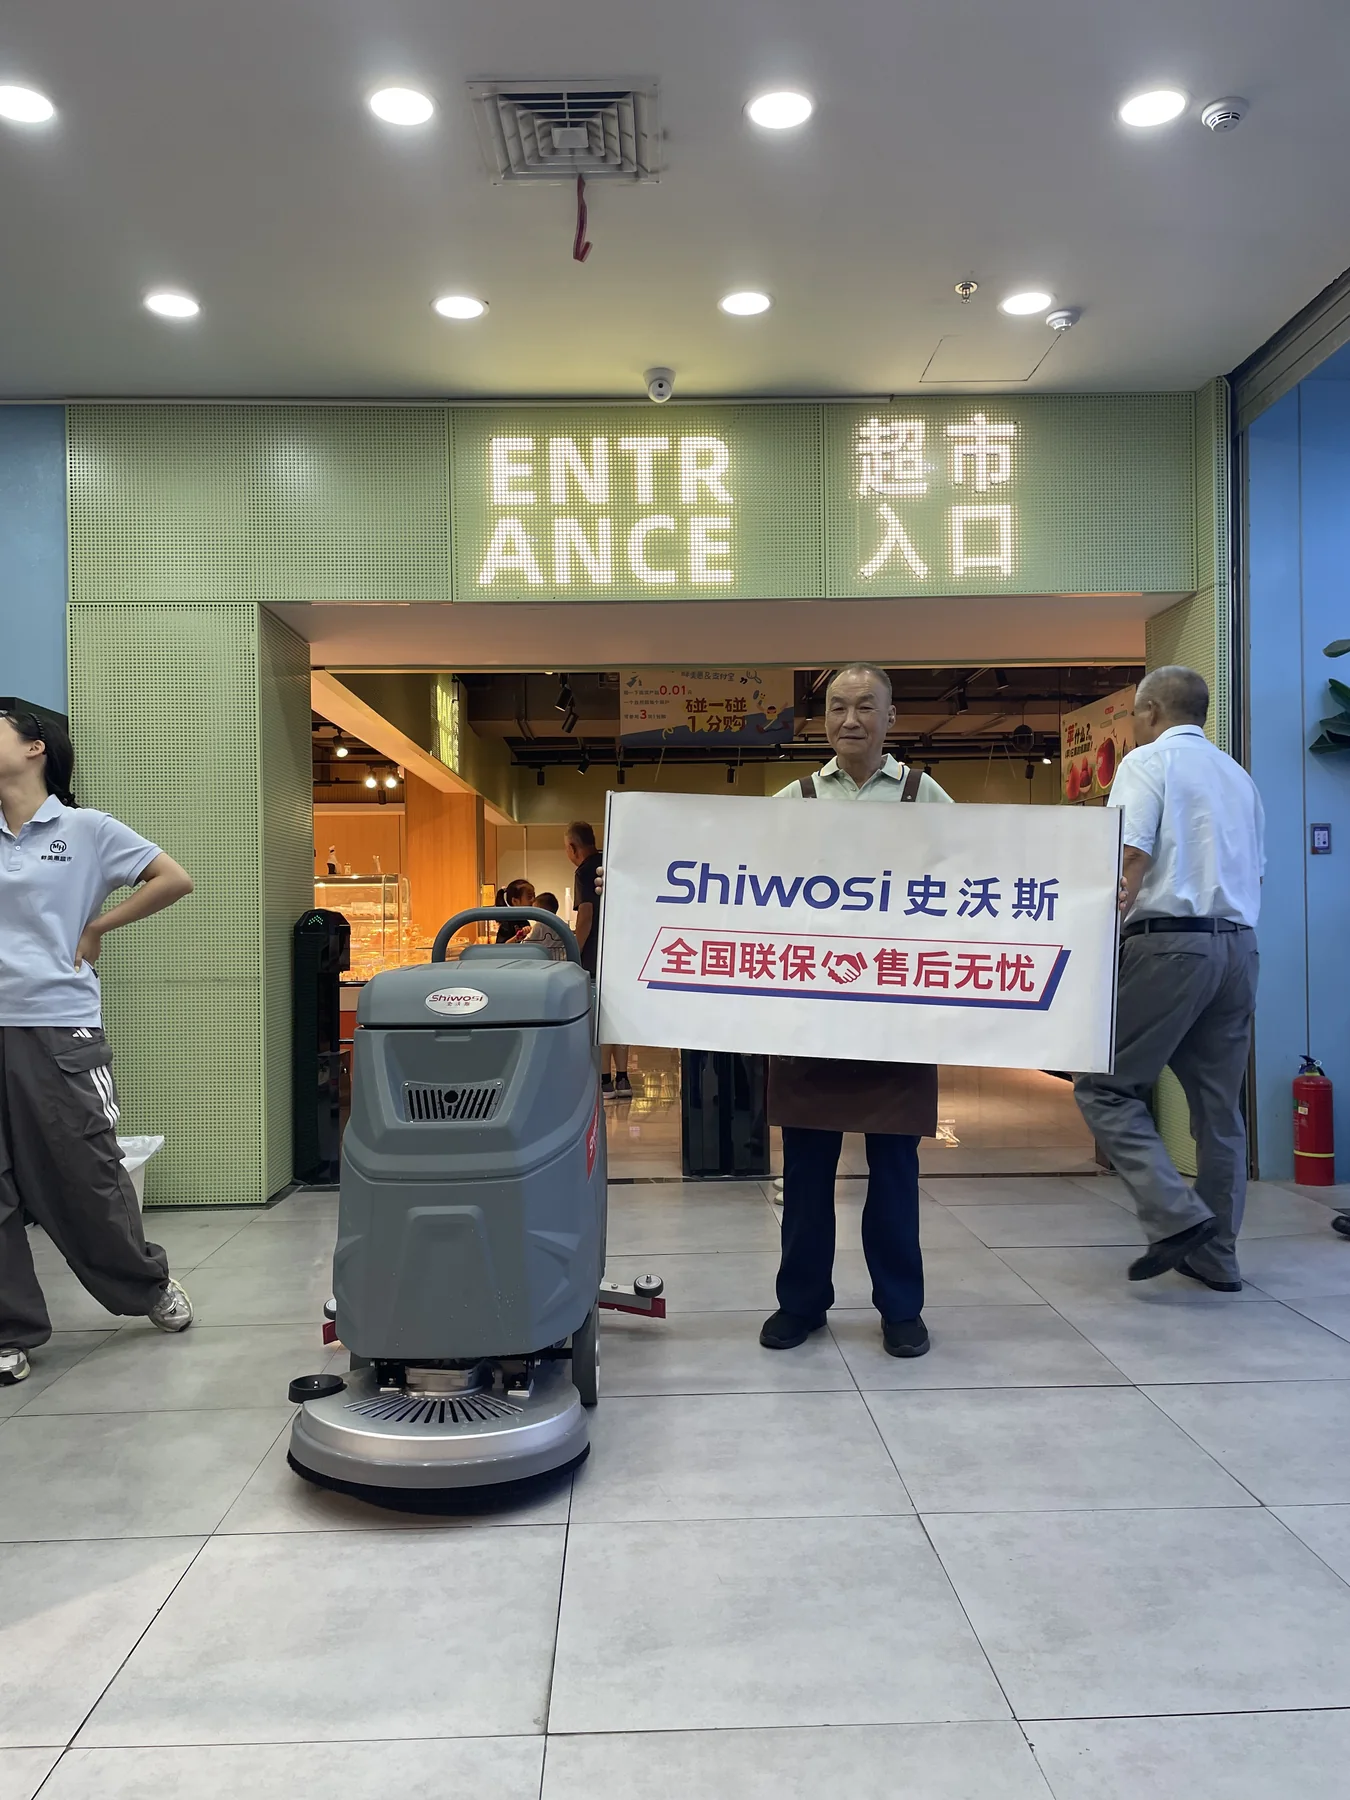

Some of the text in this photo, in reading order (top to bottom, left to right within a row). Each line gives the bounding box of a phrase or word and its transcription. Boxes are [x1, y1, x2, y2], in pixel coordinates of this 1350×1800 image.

[490, 436, 734, 504] ENTR
[856, 412, 1016, 496] 超市
[478, 514, 734, 585] ANCE
[859, 502, 1012, 580] 入口
[685, 697, 748, 714] 碰一碰
[655, 860, 893, 912] Shiwosi
[903, 874, 1060, 922] 史沃斯
[660, 937, 1036, 993] 全国联保 售后无忧
[428, 994, 484, 1002] Shiwosi
